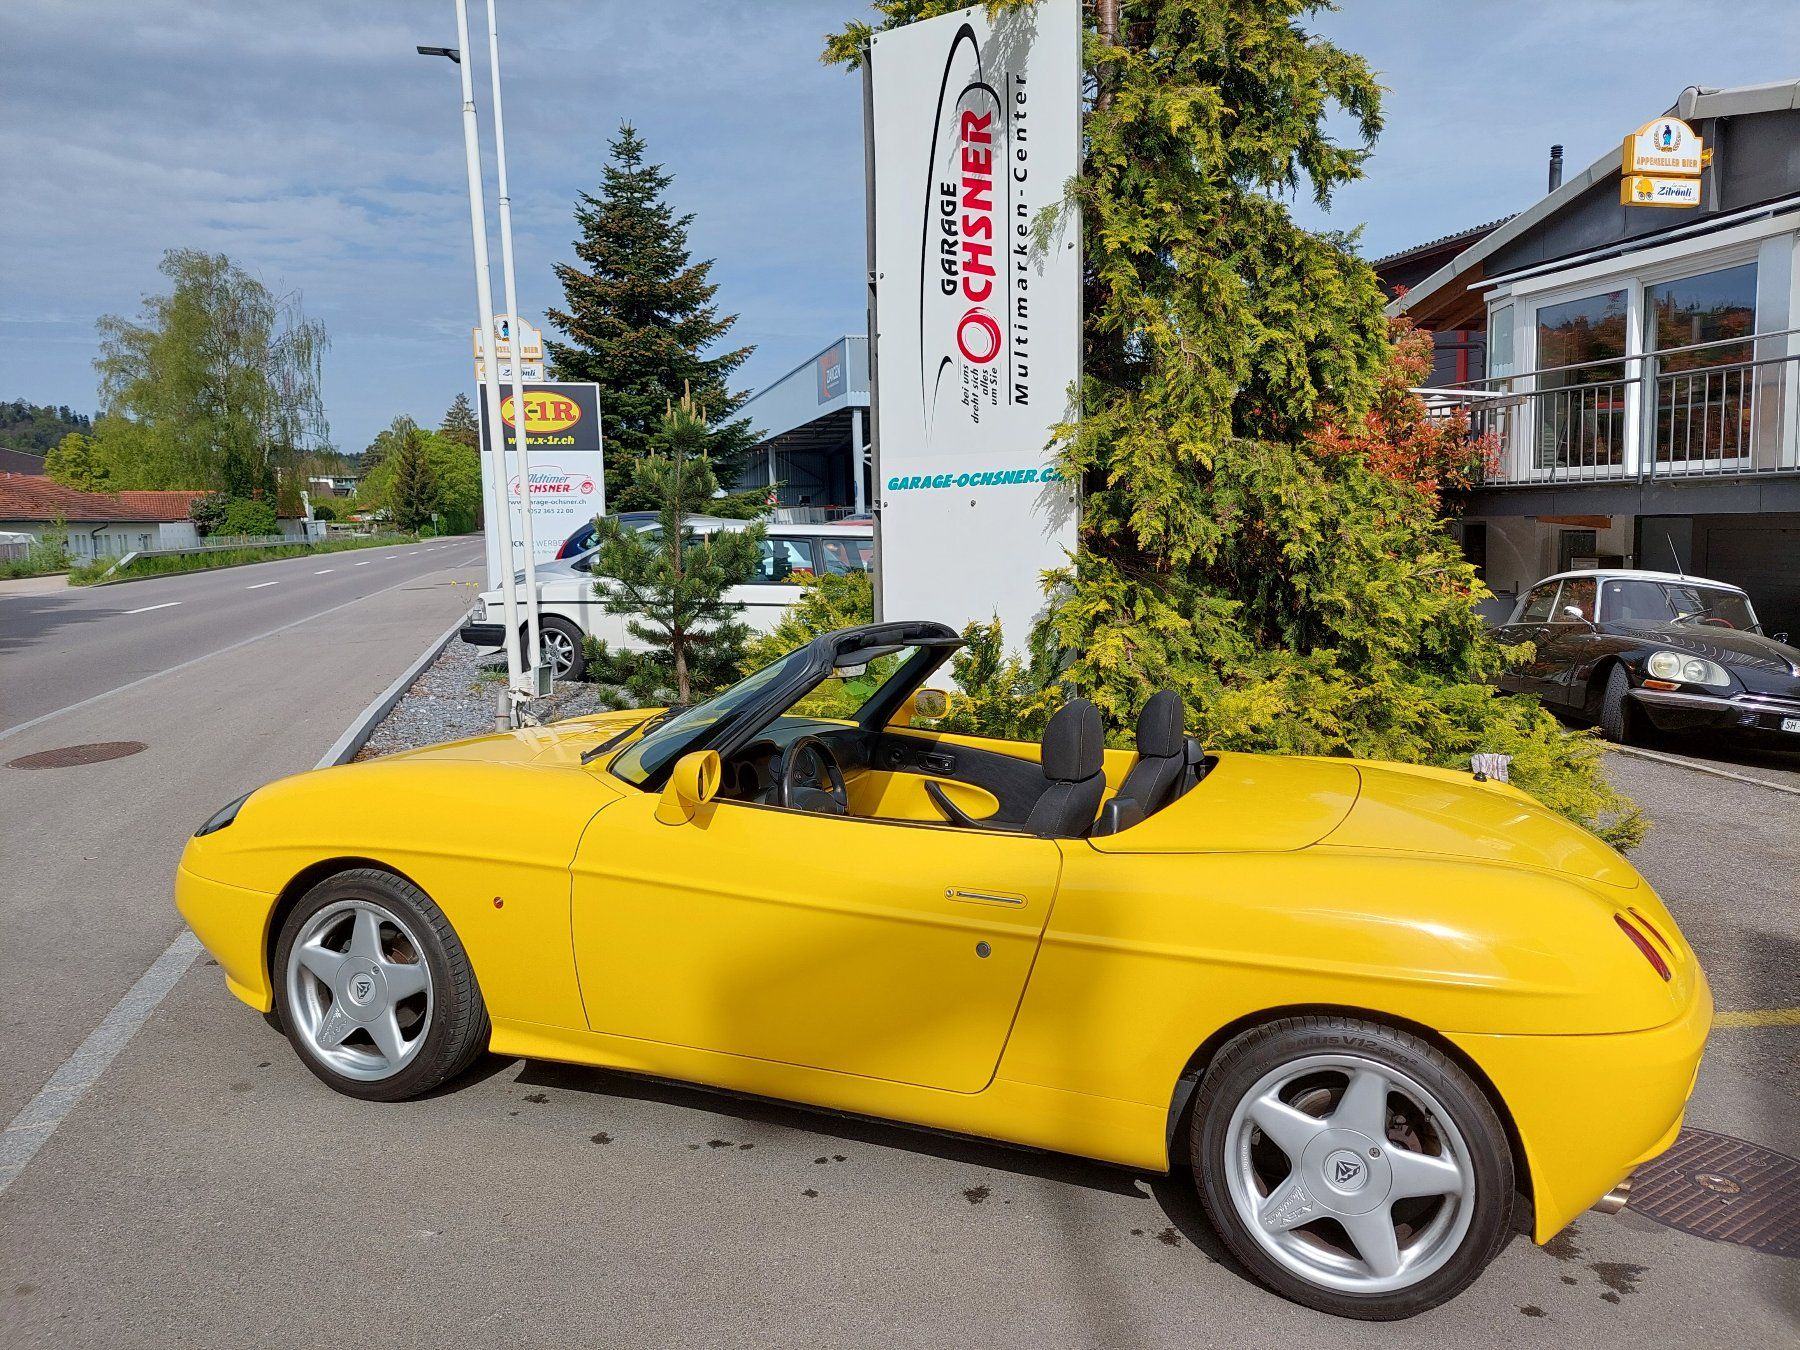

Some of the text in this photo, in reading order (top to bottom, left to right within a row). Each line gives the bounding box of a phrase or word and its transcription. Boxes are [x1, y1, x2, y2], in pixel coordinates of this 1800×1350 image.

[1657, 186, 1692, 197] Zitrönli
[940, 182, 959, 296] GARAGE
[956, 110, 1002, 364] OCHSNER
[1013, 74, 1029, 406] Multimarken-Center
[960, 364, 970, 406] bei uns
[970, 368, 980, 424] dreht sich
[979, 368, 989, 396] alles
[989, 367, 998, 406] um Sie
[507, 435, 575, 445] ww.x-1r.ch
